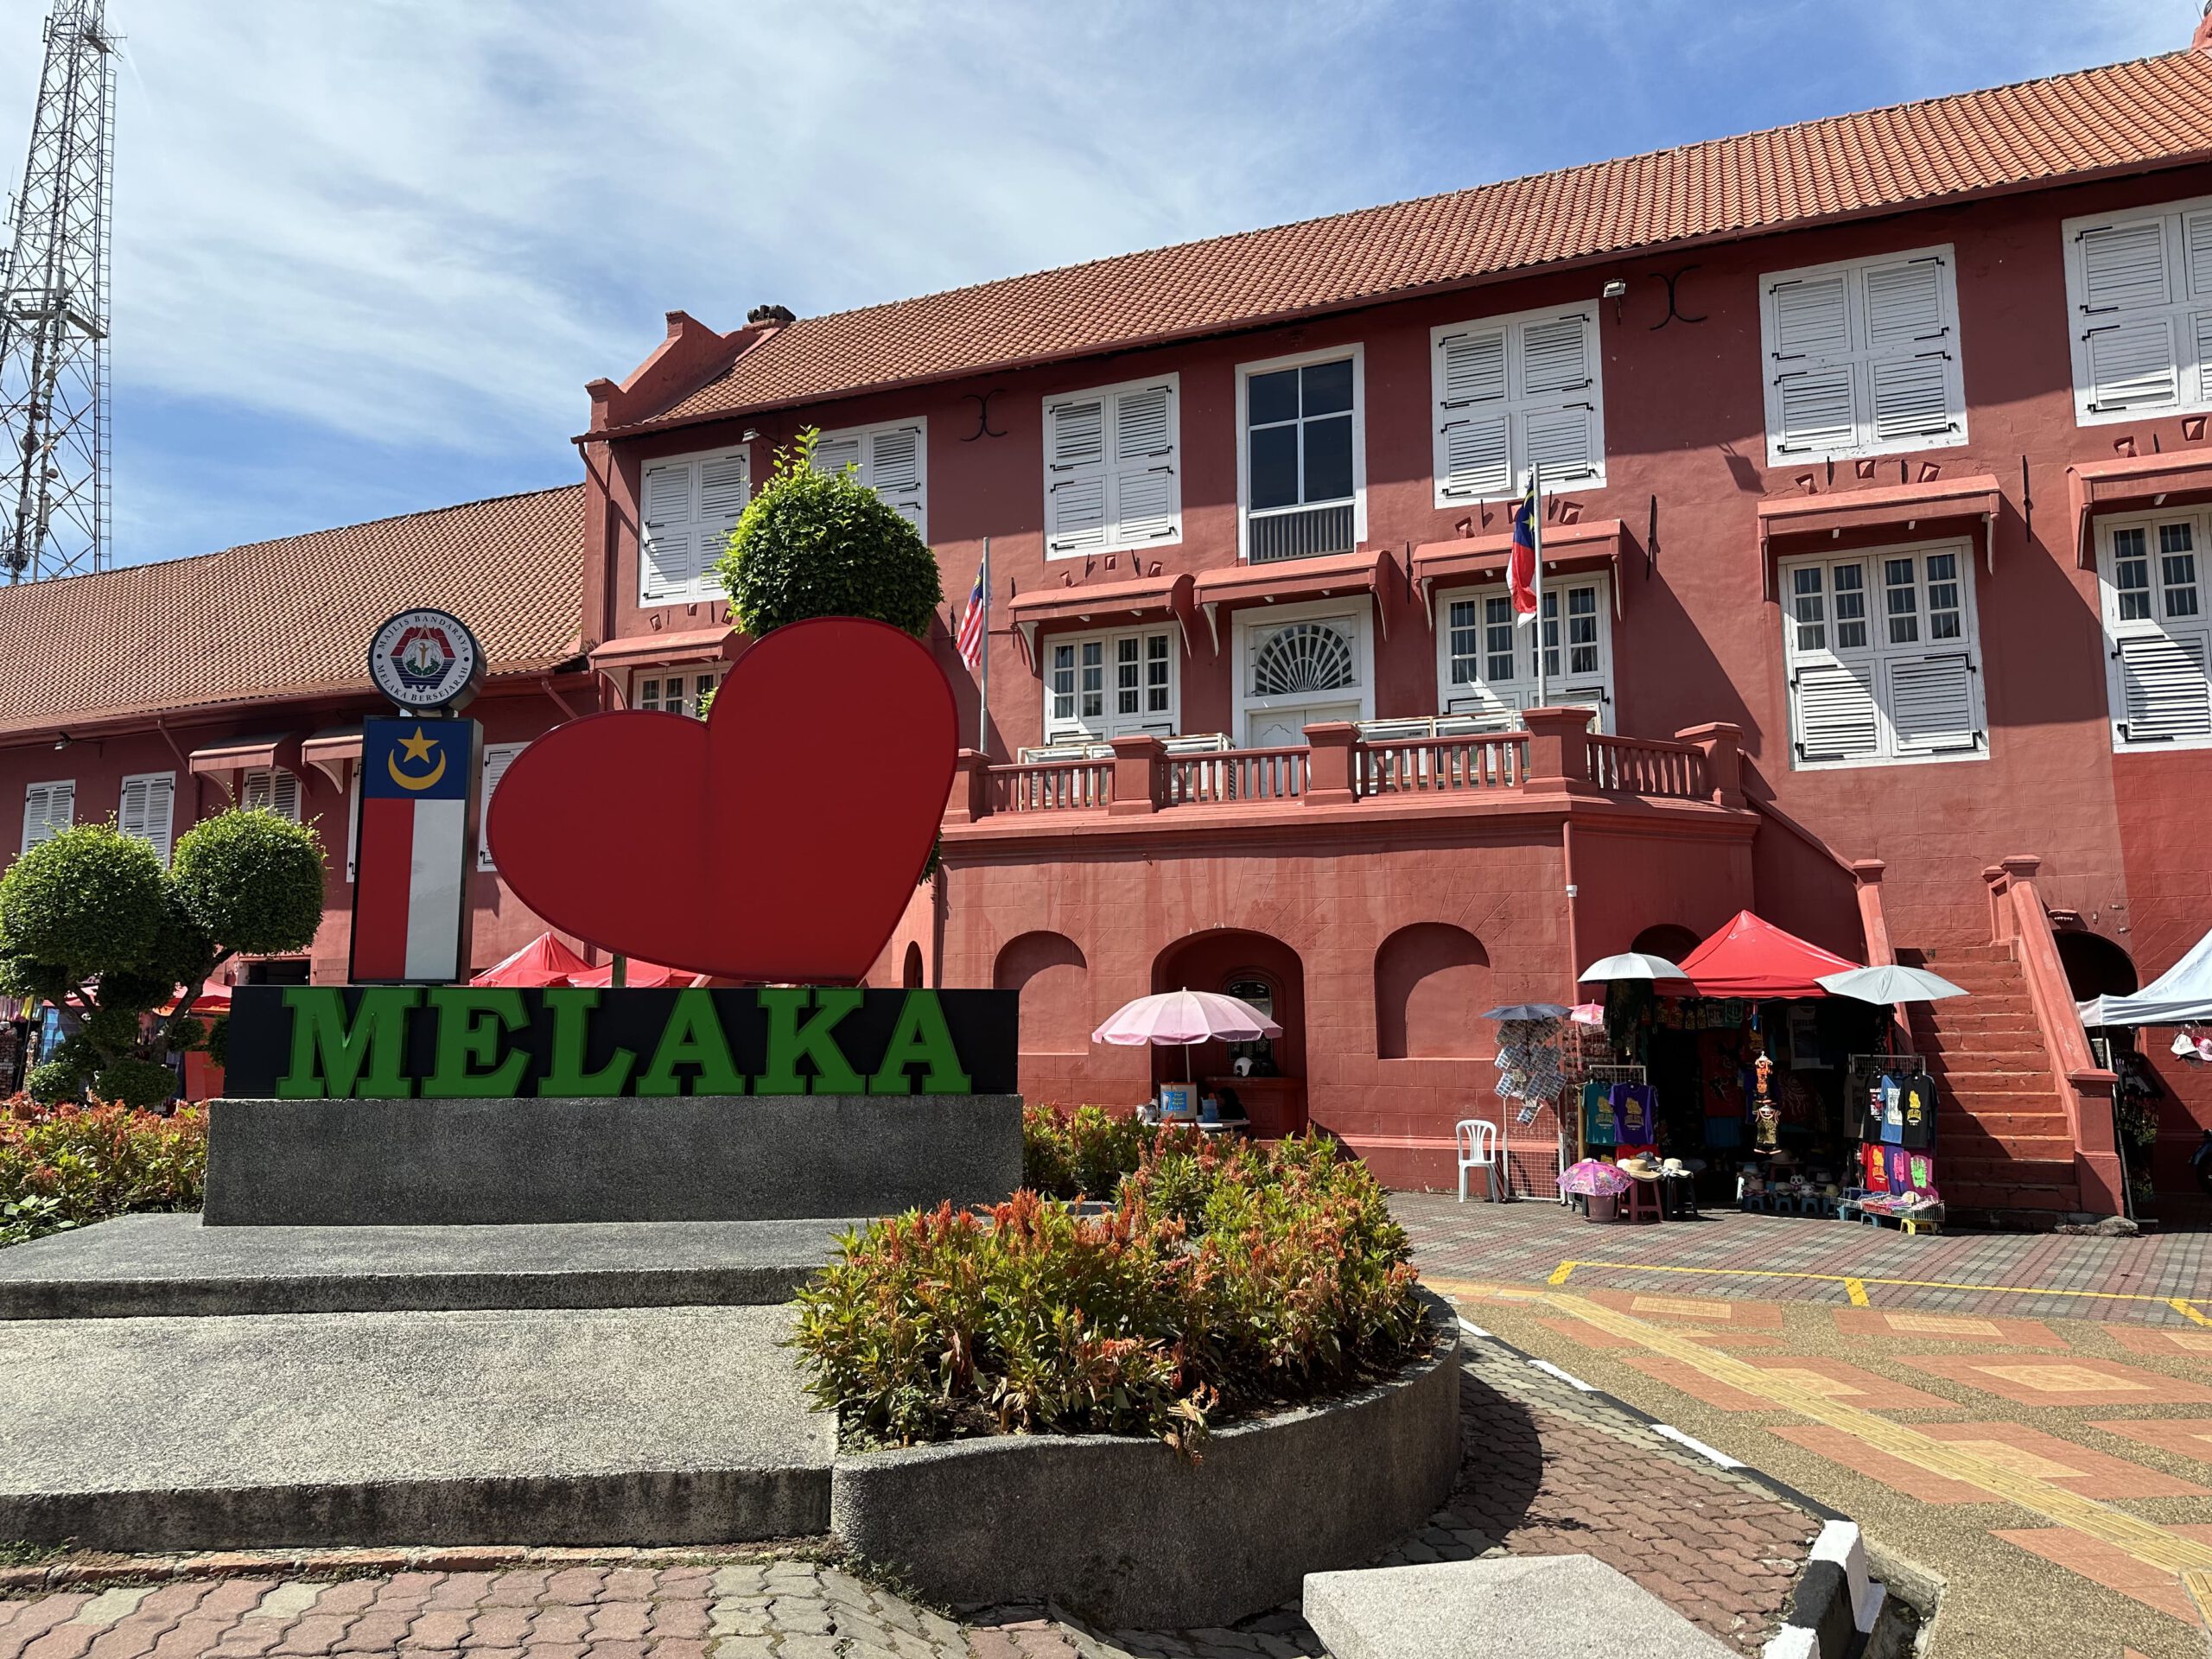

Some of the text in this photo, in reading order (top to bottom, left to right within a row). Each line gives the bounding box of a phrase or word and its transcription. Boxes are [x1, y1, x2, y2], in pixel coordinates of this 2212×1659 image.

[378, 615, 468, 652] MAJLIS BANDARAYA
[377, 664, 468, 702] MELAKA BERSEJARAH
[276, 987, 972, 1100] MELAKA
